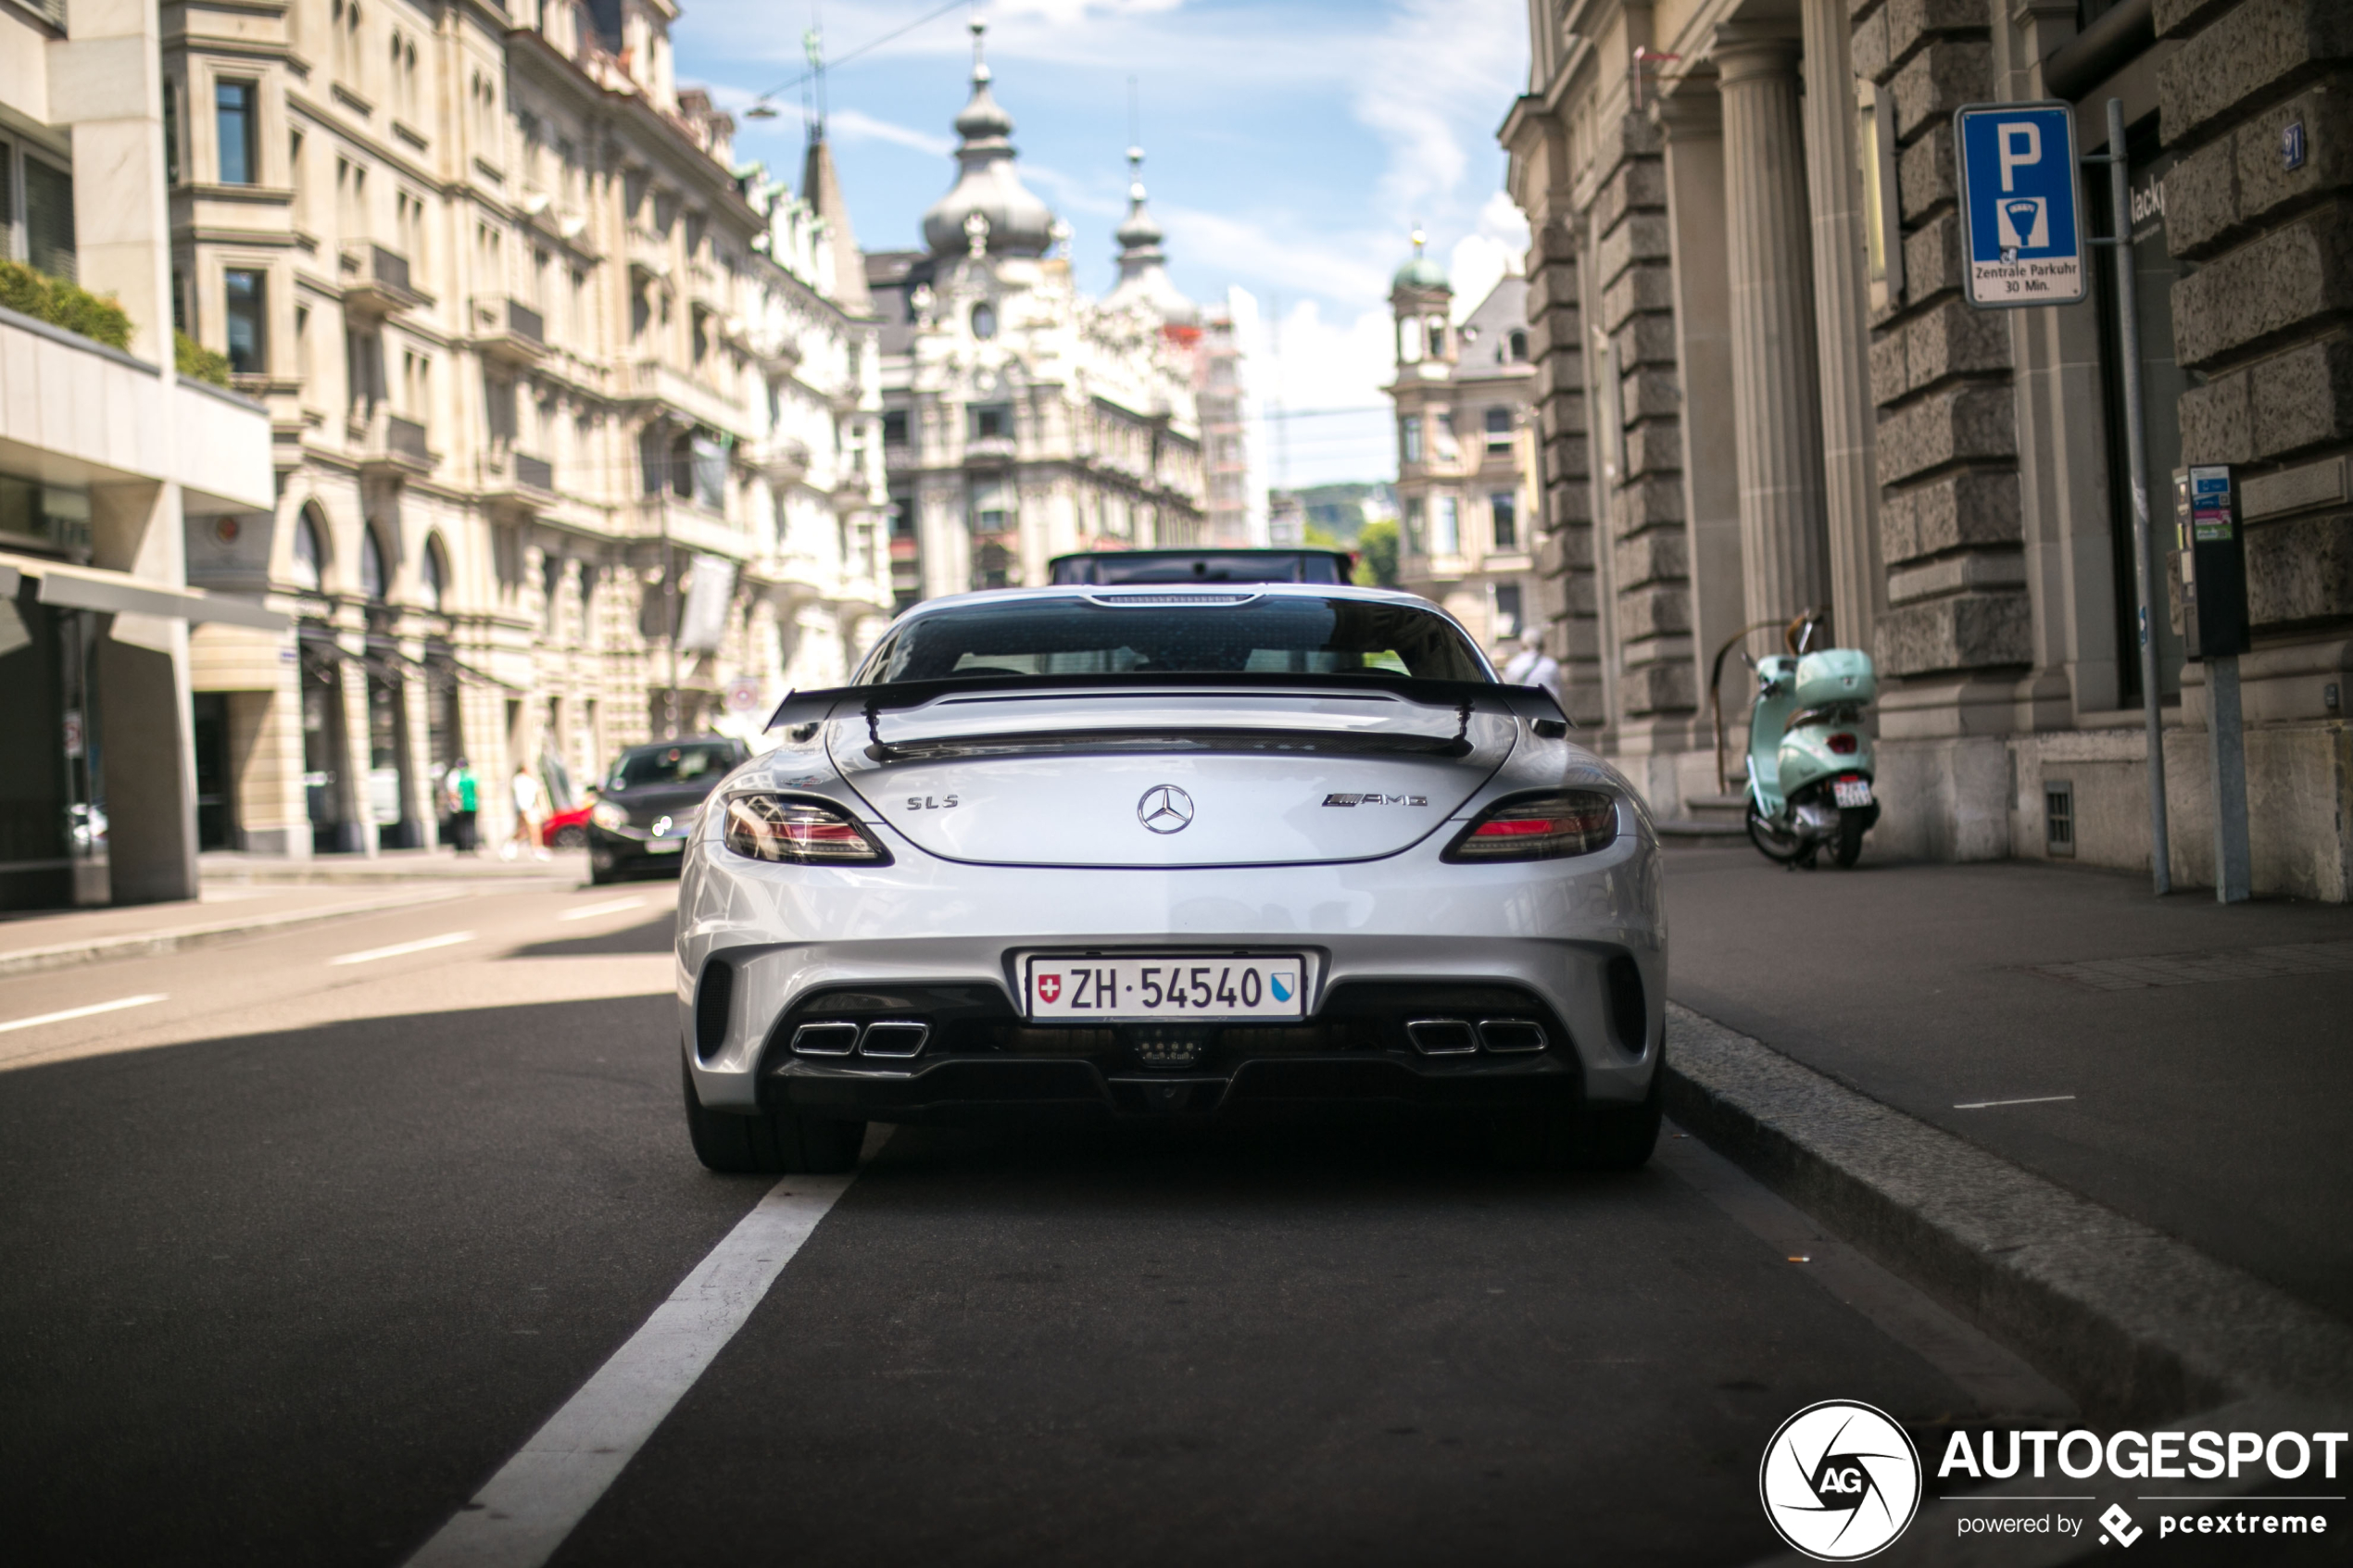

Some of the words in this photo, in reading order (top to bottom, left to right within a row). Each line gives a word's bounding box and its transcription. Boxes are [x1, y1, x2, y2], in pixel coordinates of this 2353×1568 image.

[1997, 121, 2042, 192] P
[1975, 265, 2026, 279] Zentrale
[2031, 262, 2077, 276] Parkuhr
[2005, 281, 2020, 293] 30
[2025, 280, 2050, 293] Min.
[906, 794, 959, 811] SLS
[1358, 793, 1428, 807] AMG
